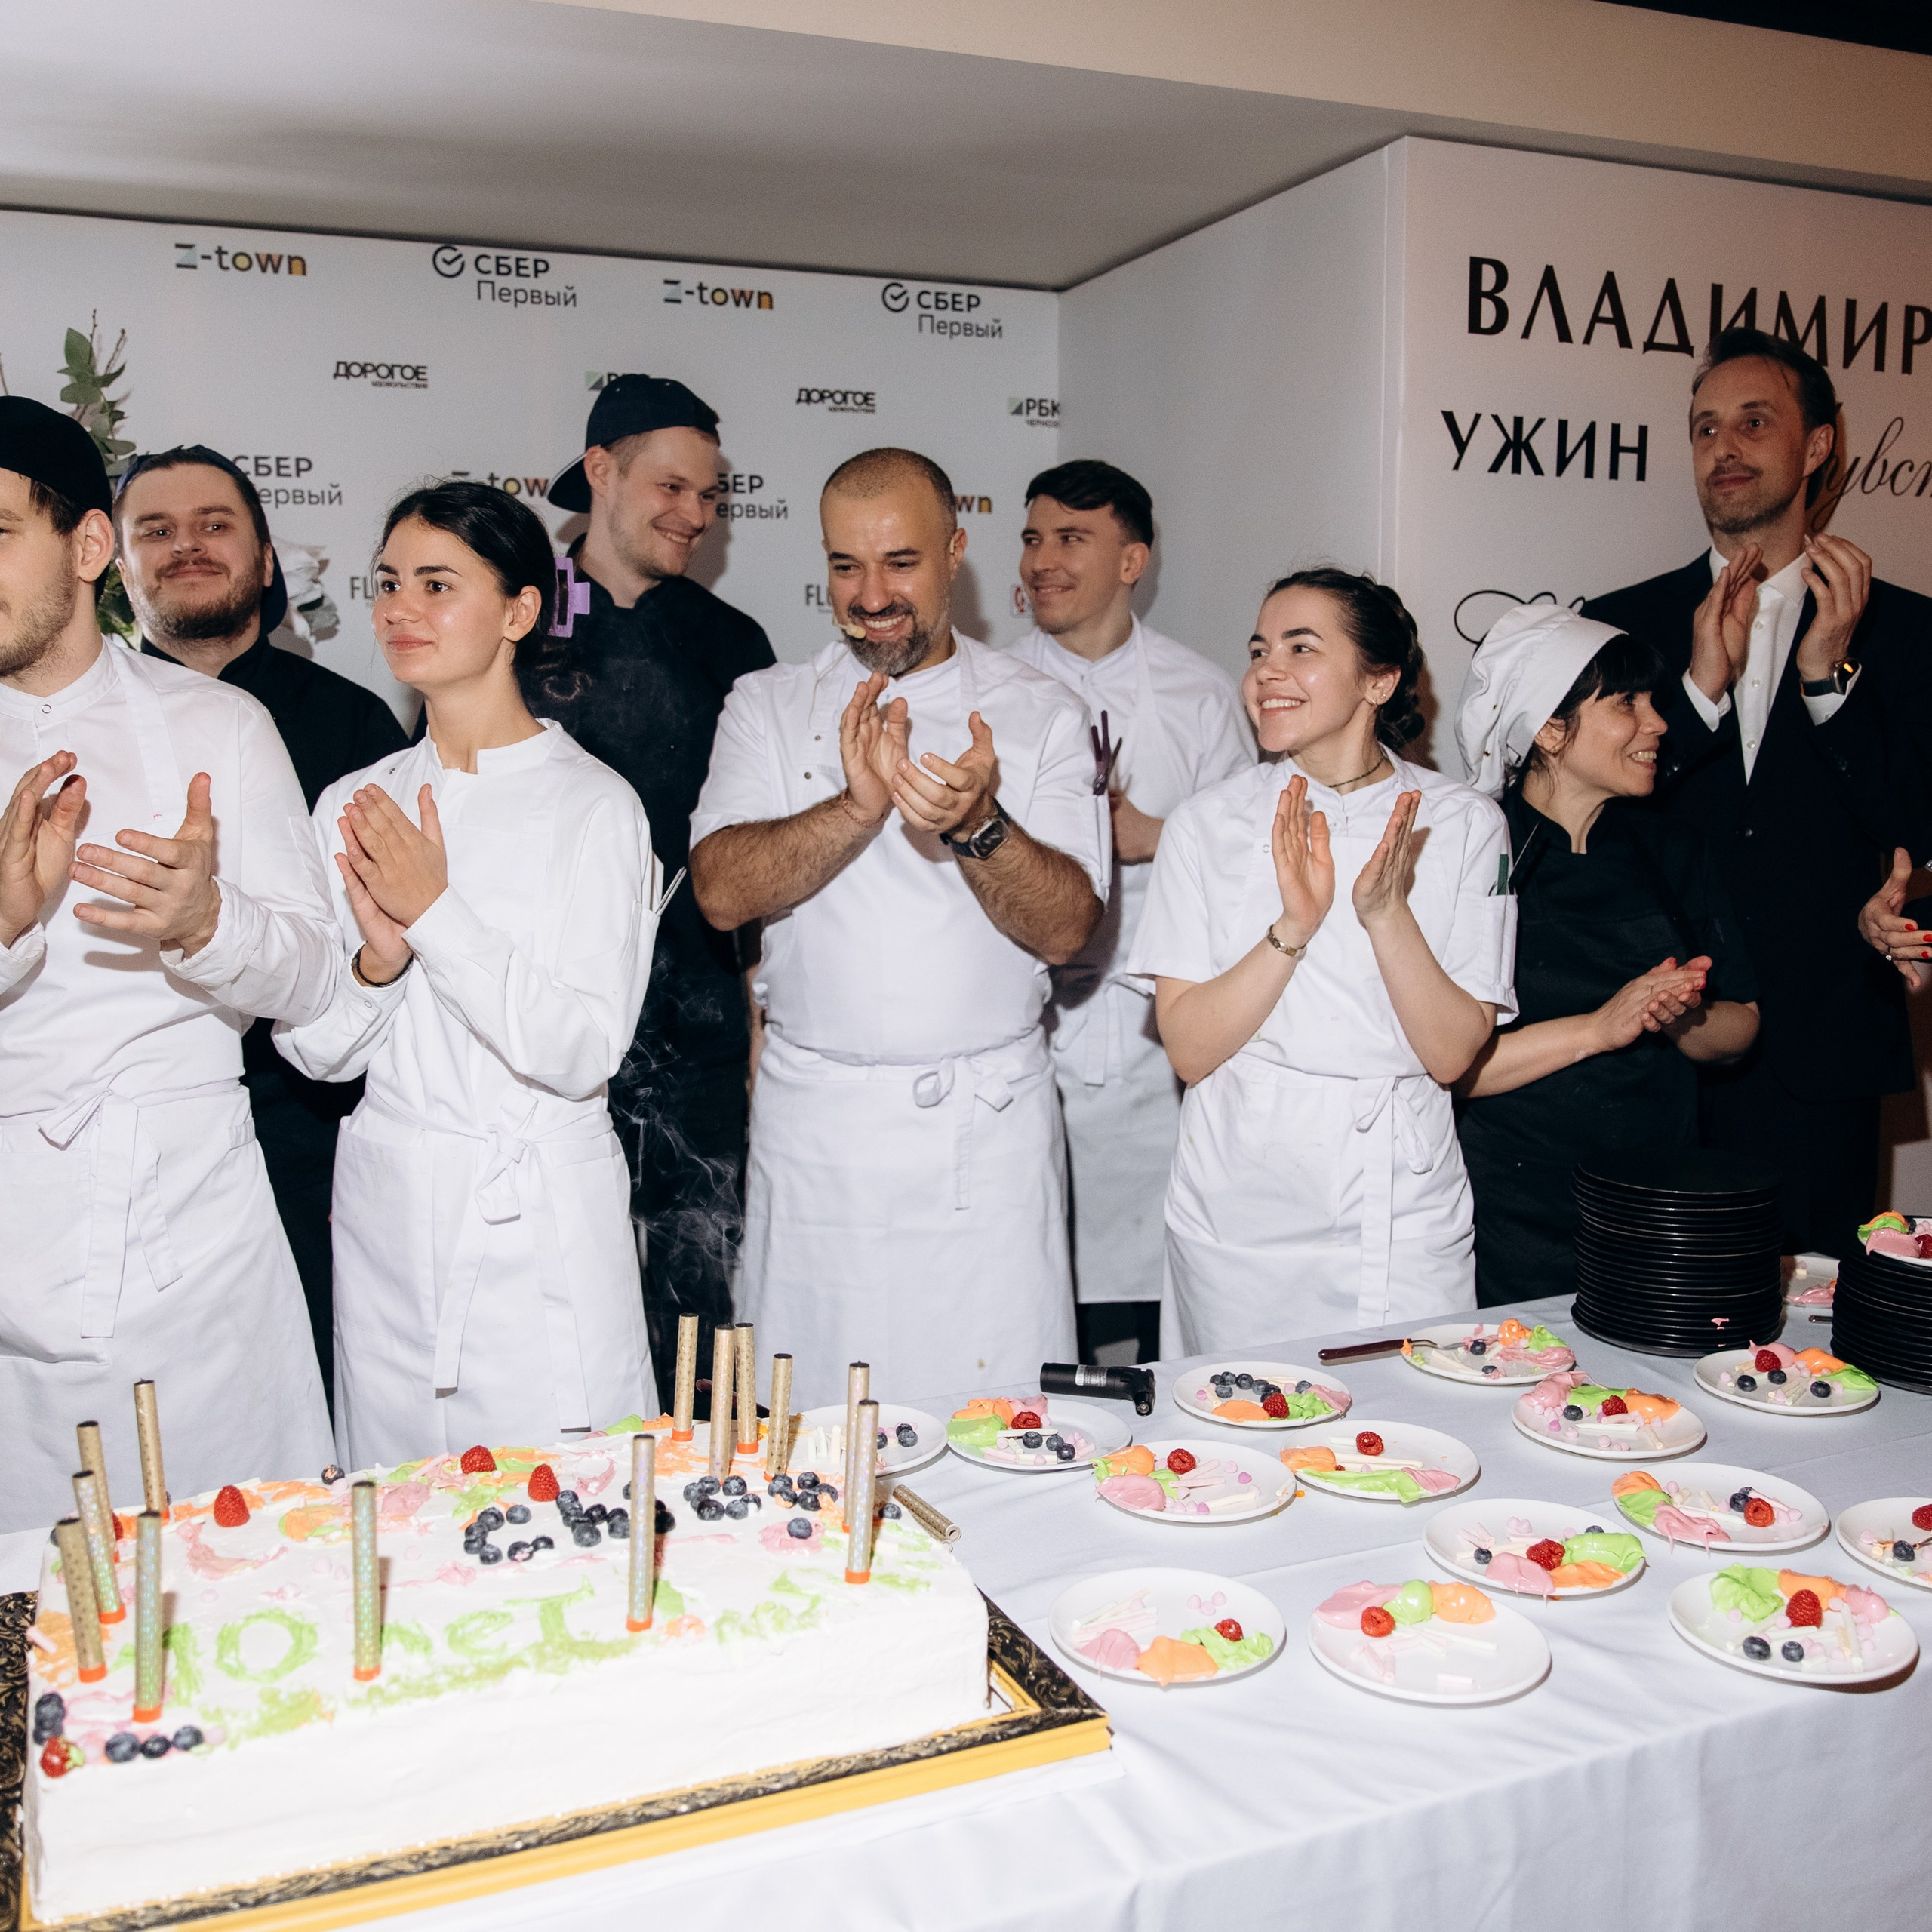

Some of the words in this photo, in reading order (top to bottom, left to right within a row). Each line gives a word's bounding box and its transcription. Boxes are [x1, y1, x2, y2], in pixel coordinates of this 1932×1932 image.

[474, 254, 550, 279] СБЕР
[476, 280, 577, 308] Первый
[916, 290, 980, 313] СБЕР
[918, 313, 1003, 339] Первый
[1467, 255, 1932, 375] ВЛАДИМИР
[334, 361, 428, 381] ДОРОГОЕ
[796, 388, 875, 407] ДОРОГОЕ
[1026, 398, 1060, 417] РБК
[1441, 410, 1648, 482] УЖИН
[717, 472, 764, 494] БЕР
[257, 483, 343, 509] ервый
[715, 498, 789, 522] ервый
